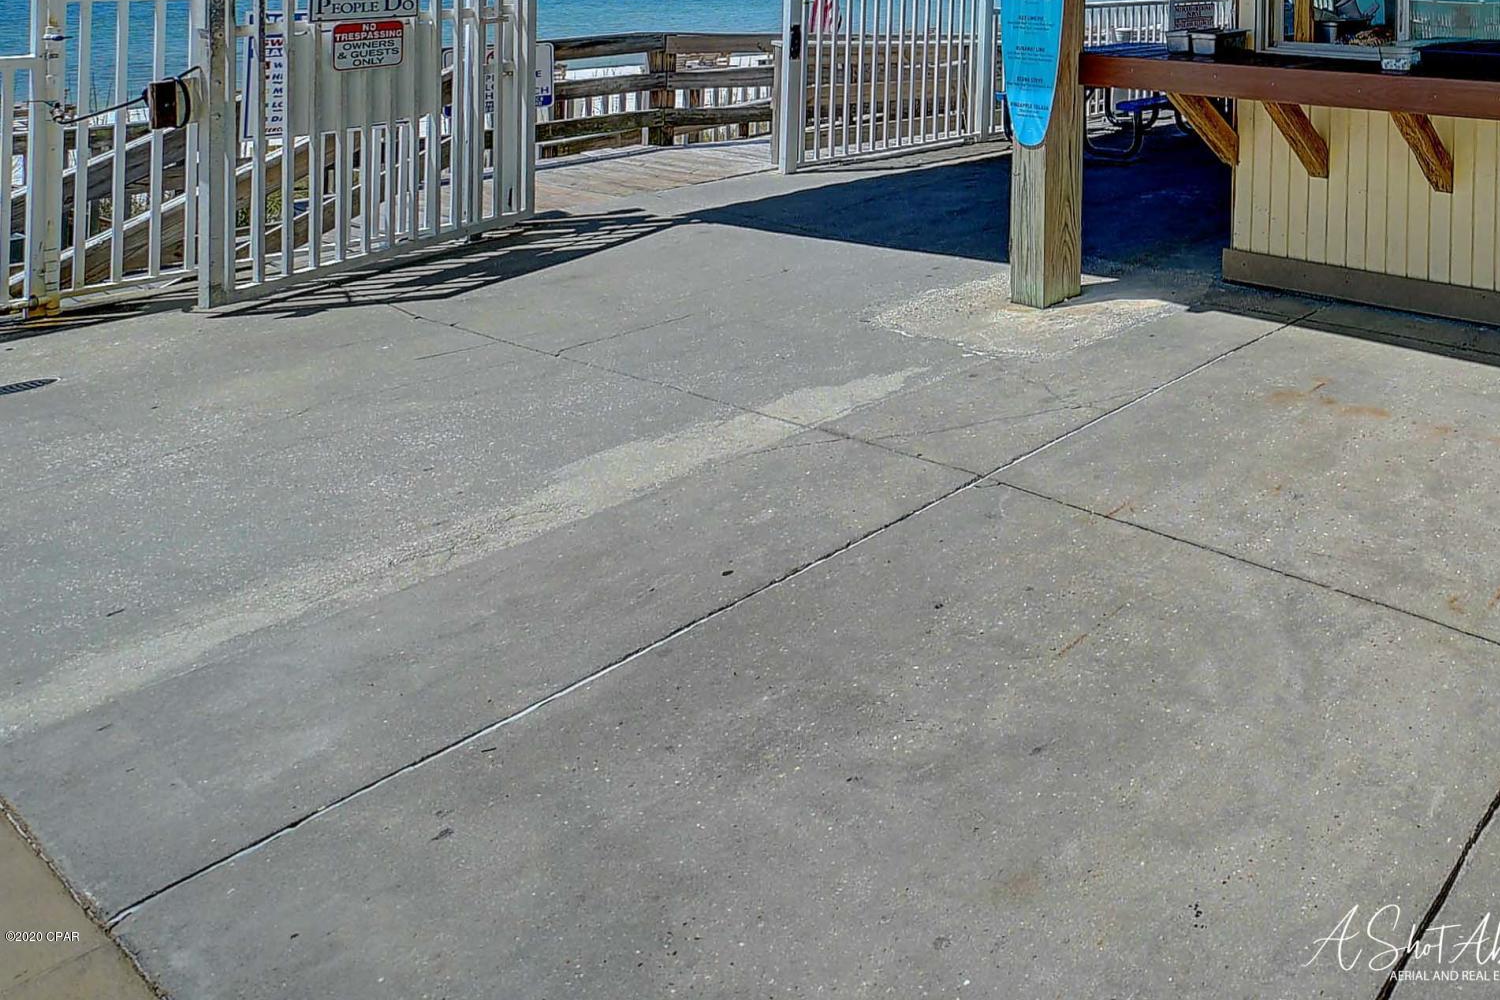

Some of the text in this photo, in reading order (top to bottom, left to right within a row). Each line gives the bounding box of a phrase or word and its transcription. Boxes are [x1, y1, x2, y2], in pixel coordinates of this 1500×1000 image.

[362, 23, 376, 31] NO
[335, 30, 402, 41] TRESPASSING
[343, 40, 395, 50] OWNERS
[337, 47, 400, 60] & GUESTS
[353, 57, 385, 66] ONLY
